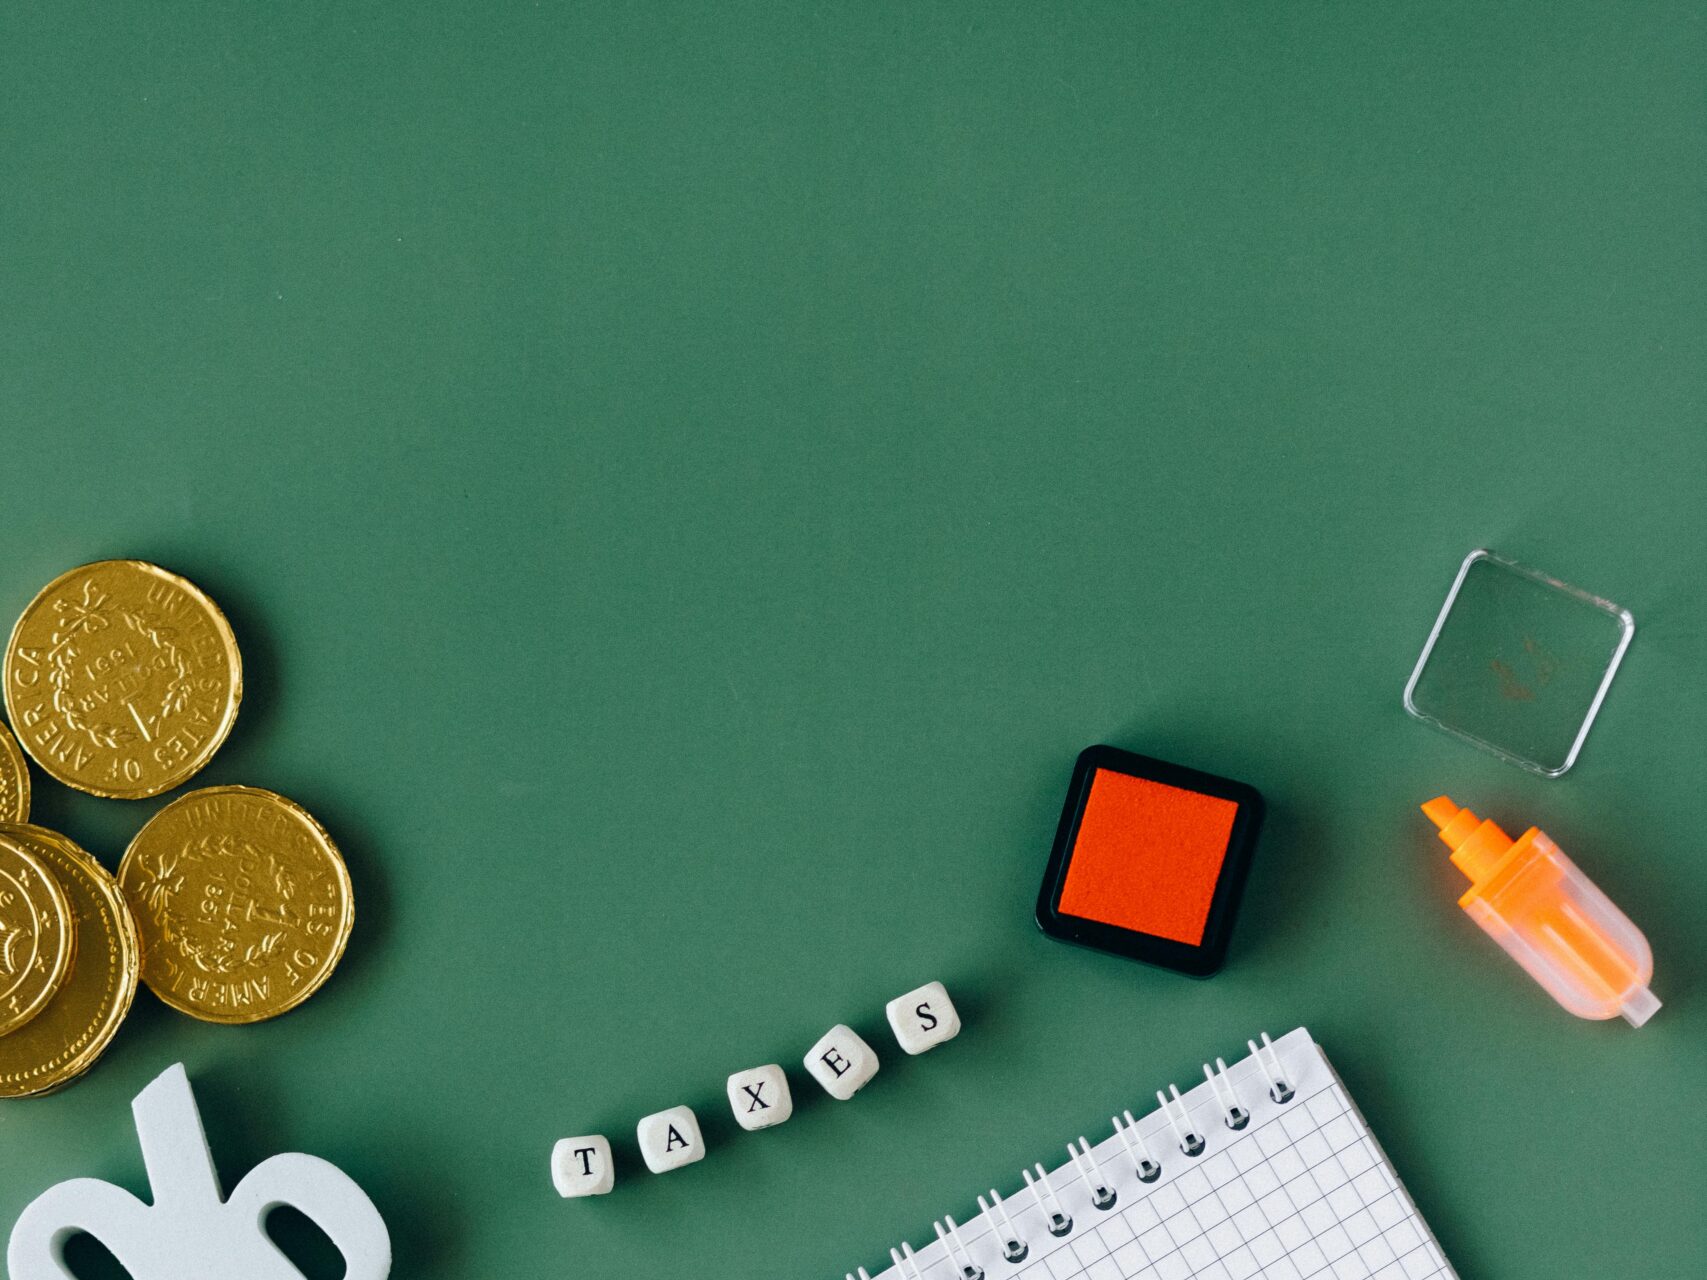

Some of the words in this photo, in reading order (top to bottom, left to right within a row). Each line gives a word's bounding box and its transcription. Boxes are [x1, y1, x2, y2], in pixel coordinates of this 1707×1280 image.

[146, 582, 222, 668] UNITED
[14, 647, 95, 773] AMERICA
[79, 653, 167, 712] DOLLAR
[153, 677, 222, 771] STATES
[103, 757, 144, 784] OF
[195, 872, 227, 925] 1851
[215, 857, 256, 953] DOLLAR
[293, 834, 337, 937] STATES
[280, 948, 319, 987] OF
[574, 1002, 938, 1176] TAXES
